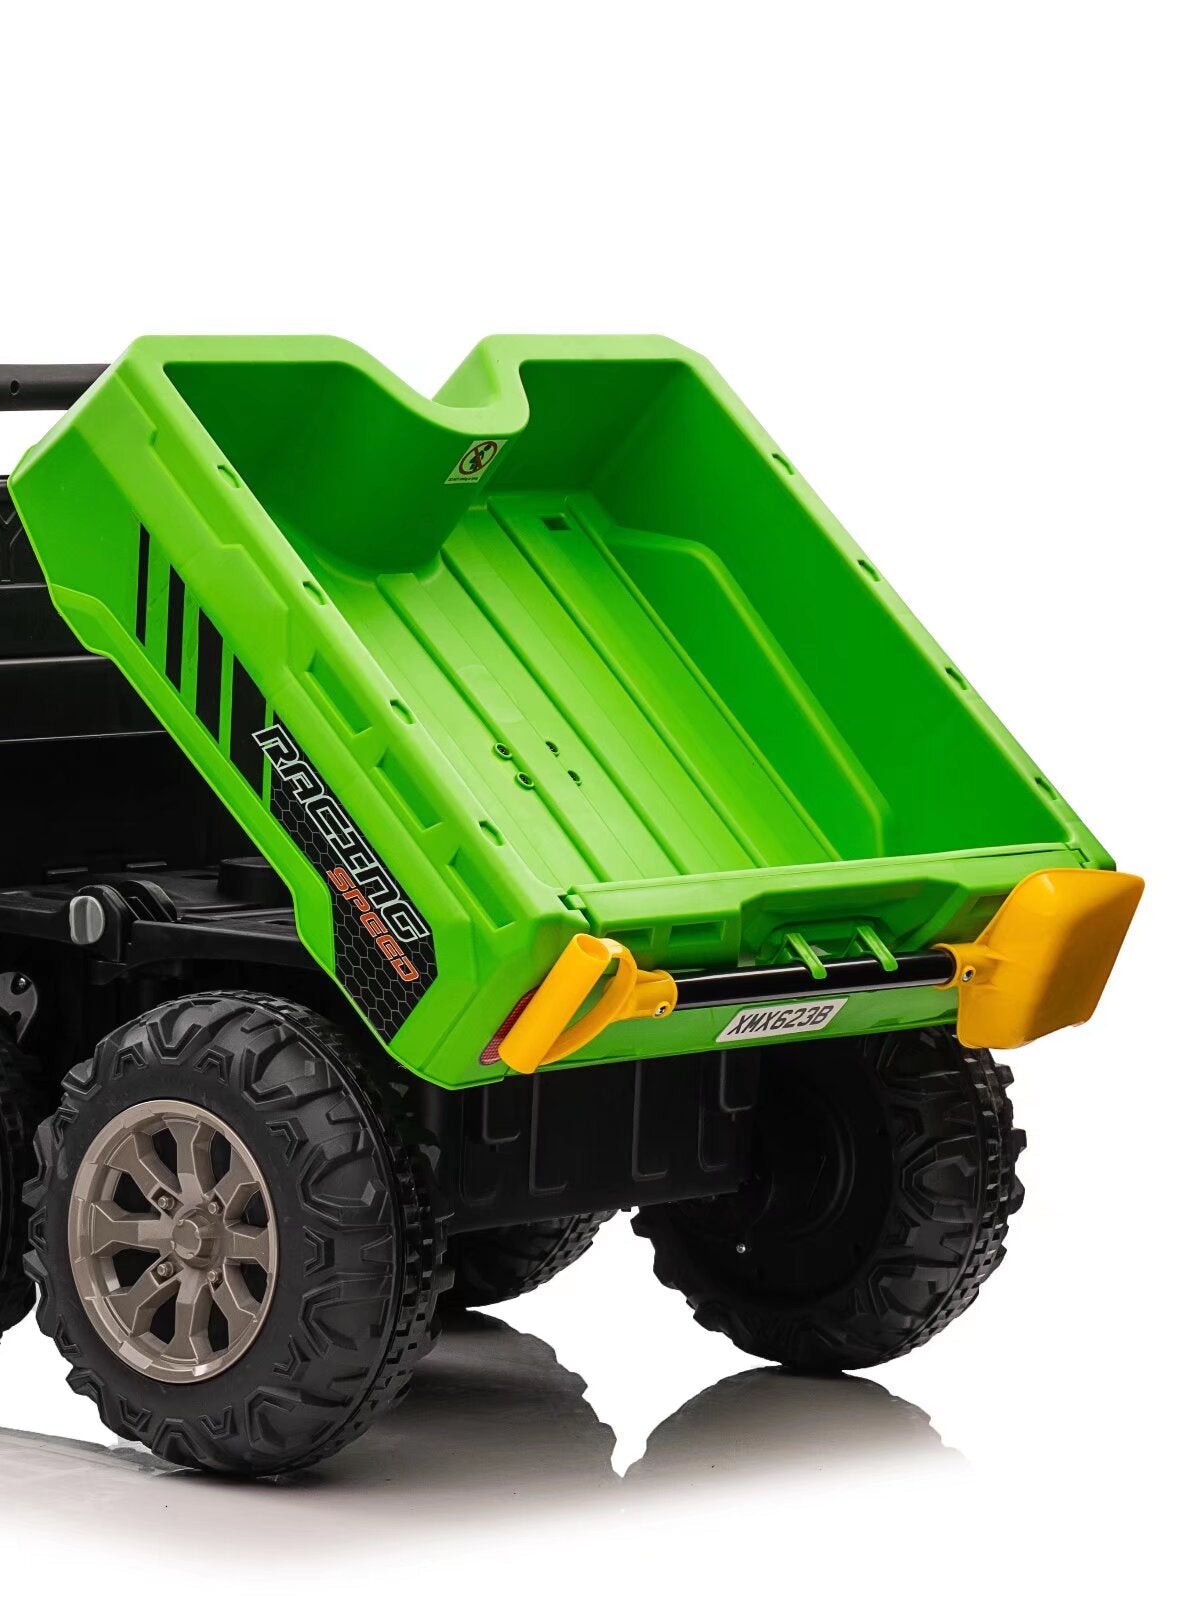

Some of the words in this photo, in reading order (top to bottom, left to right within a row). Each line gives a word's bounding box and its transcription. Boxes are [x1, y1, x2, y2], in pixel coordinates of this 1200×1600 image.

[252, 724, 430, 943] RACING
[327, 867, 419, 982] SPEED
[728, 1005, 834, 1035] XMX623B
